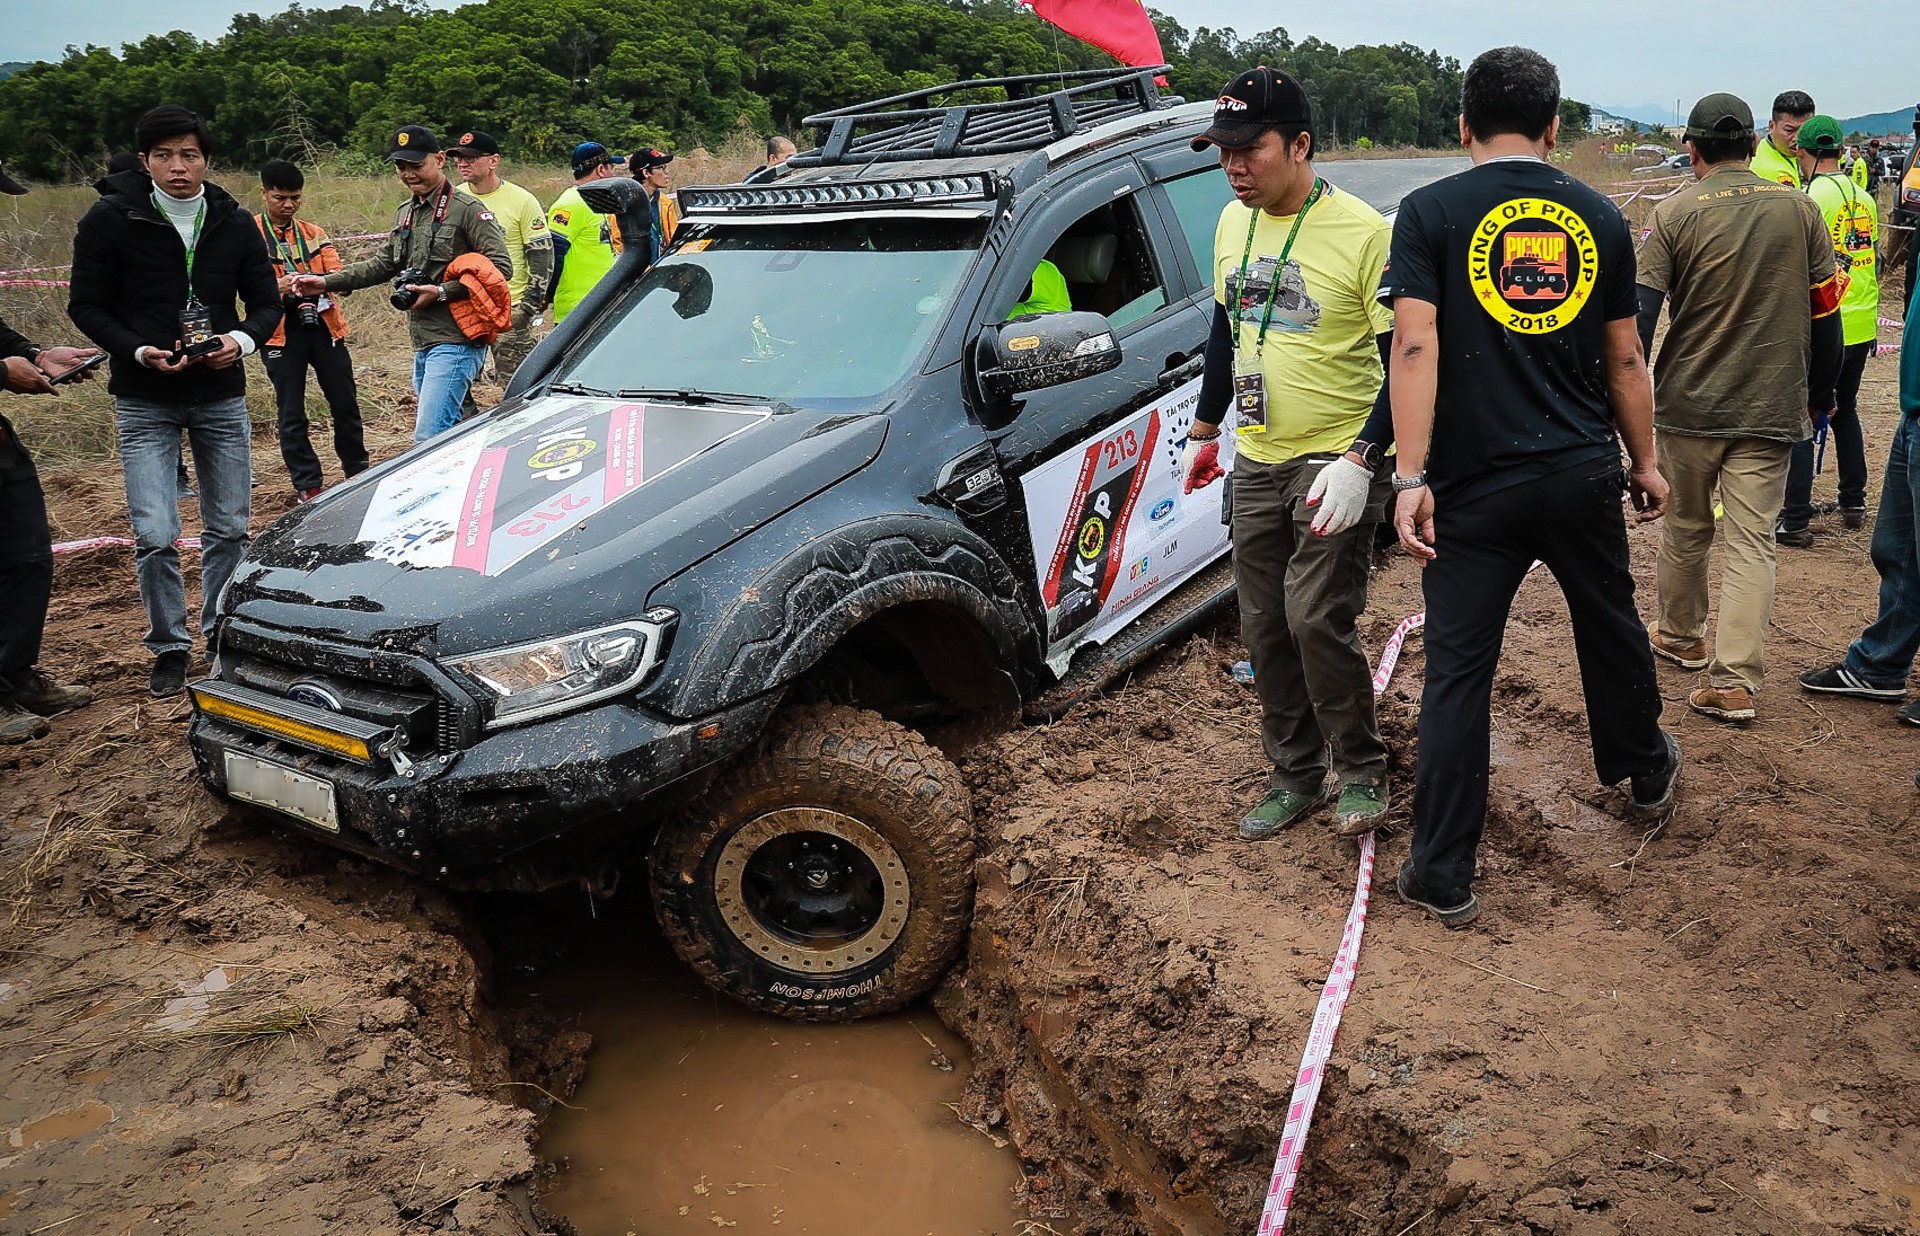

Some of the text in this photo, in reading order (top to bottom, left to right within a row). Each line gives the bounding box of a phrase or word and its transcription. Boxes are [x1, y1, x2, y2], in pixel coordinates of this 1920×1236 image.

[1697, 194, 1711, 202] WE
[1715, 189, 1734, 198] LIVE
[1739, 187, 1749, 196] TO
[1473, 202, 1594, 282] KING OF PICKUP
[1834, 213, 1844, 246] KING
[1506, 236, 1564, 261] PICKUP
[1514, 275, 1556, 283] CLUB
[1508, 313, 1559, 330] 2018
[1104, 429, 1138, 470] 213
[507, 493, 590, 537] 213
[1111, 574, 1160, 613] MINH GIANG
[769, 975, 884, 1001] THOMPSON
